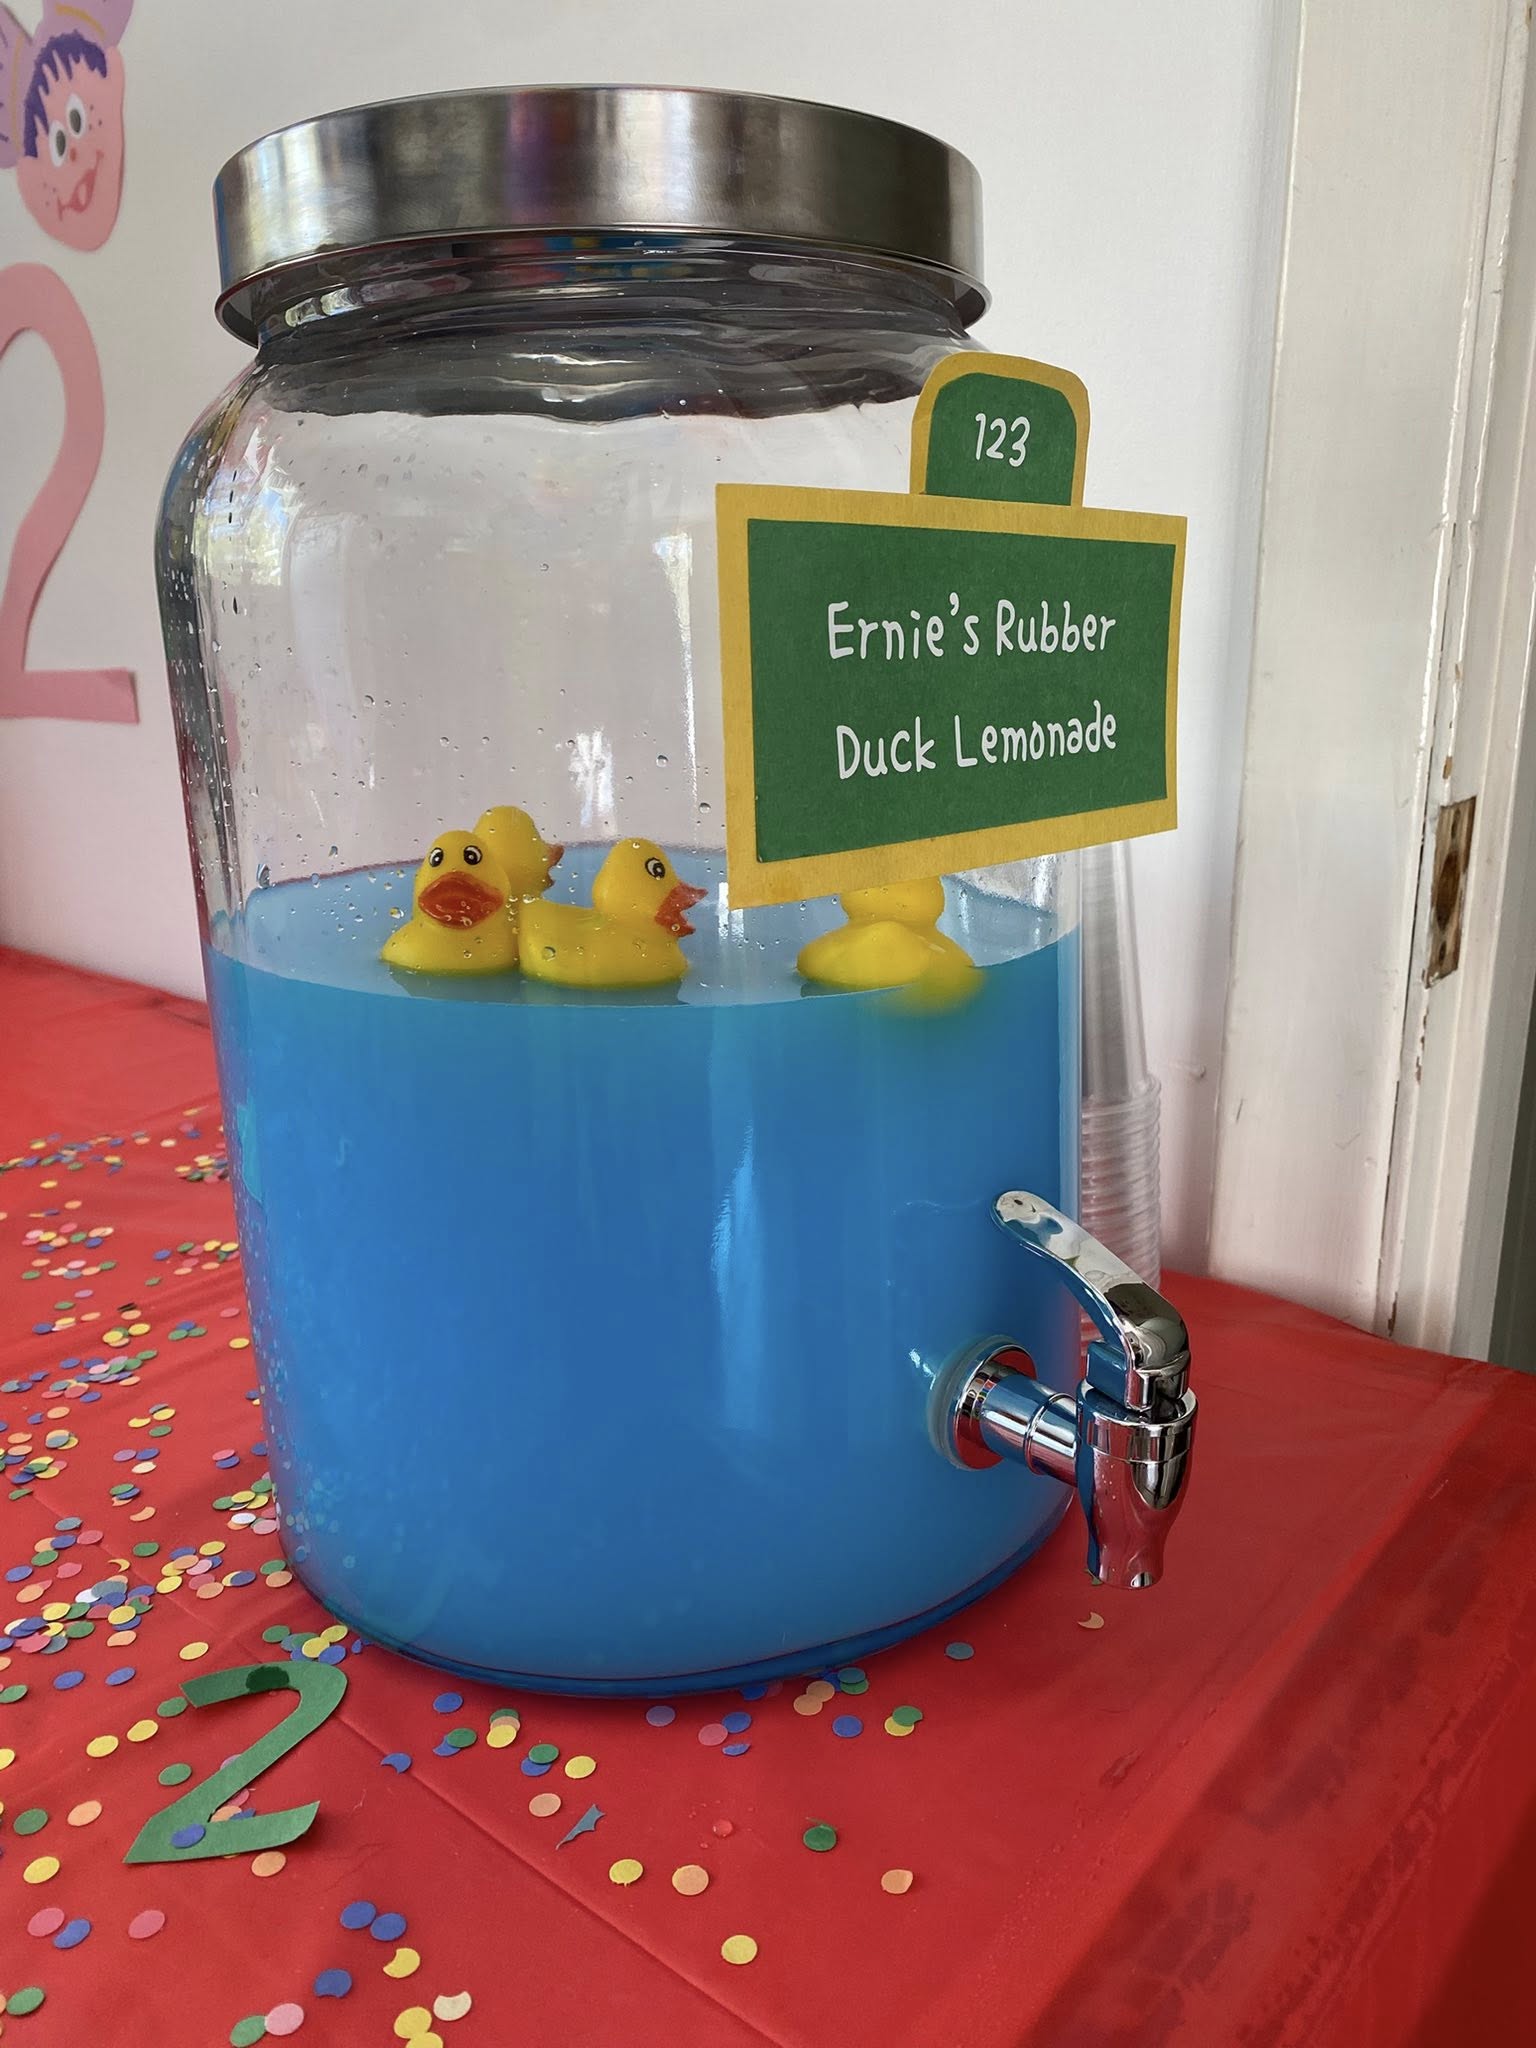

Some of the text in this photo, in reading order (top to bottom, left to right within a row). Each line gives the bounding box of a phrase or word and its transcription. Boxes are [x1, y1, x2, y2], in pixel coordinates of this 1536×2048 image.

[975, 412, 1031, 468] 123
[0, 262, 139, 724] 2
[827, 591, 1117, 661] Ernie's Rubber
[836, 699, 1117, 780] Duck Lemonade
[124, 1660, 348, 1863] 2
